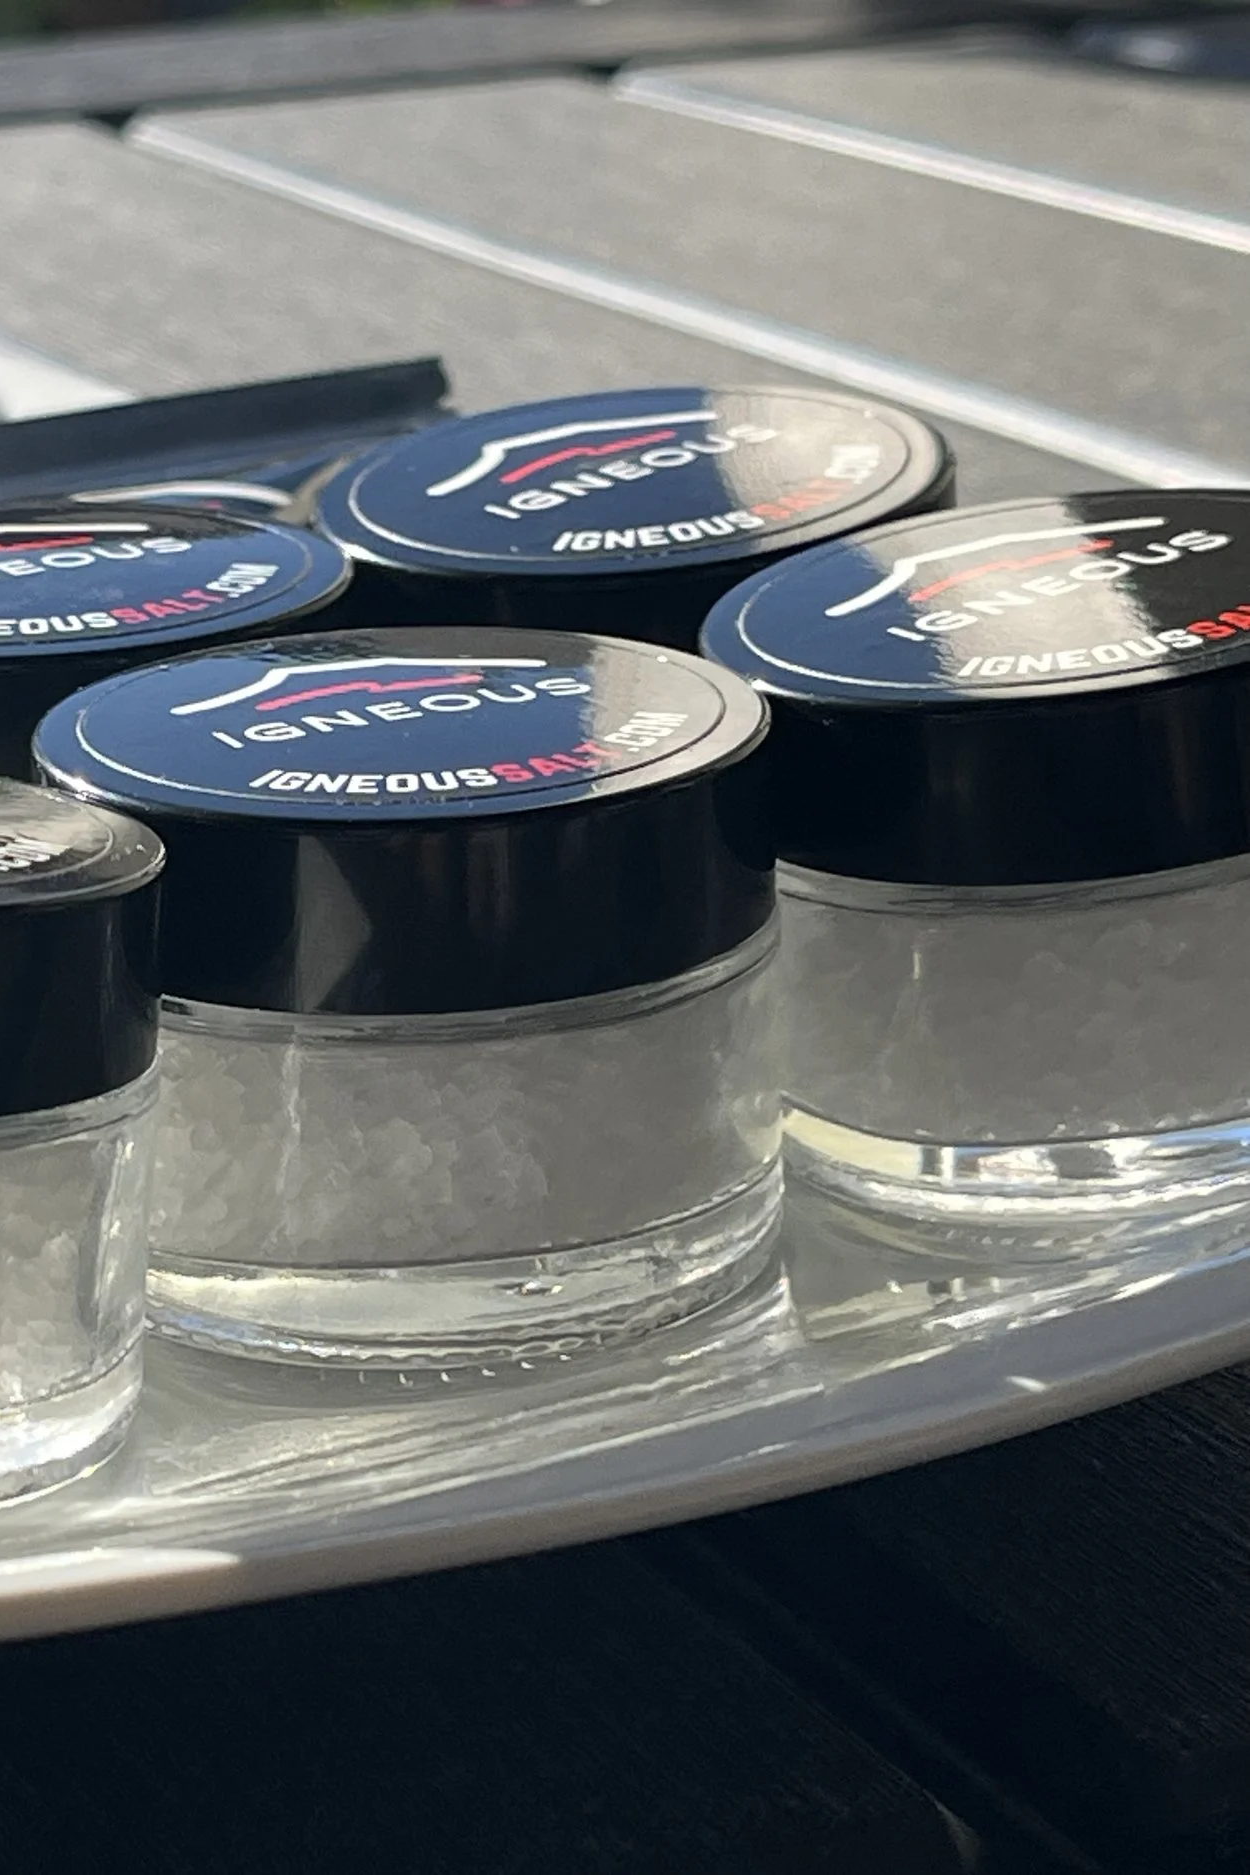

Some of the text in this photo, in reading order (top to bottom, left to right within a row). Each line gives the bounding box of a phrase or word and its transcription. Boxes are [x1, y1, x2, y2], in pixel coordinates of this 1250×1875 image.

[484, 424, 778, 520] IGNEOUS
[887, 529, 1234, 641] IGNEOUS
[957, 605, 1250, 677] IGNEOUSSA
[212, 676, 593, 749] IGNEOUS
[248, 710, 688, 795] IGNEOUSSALT.COM
